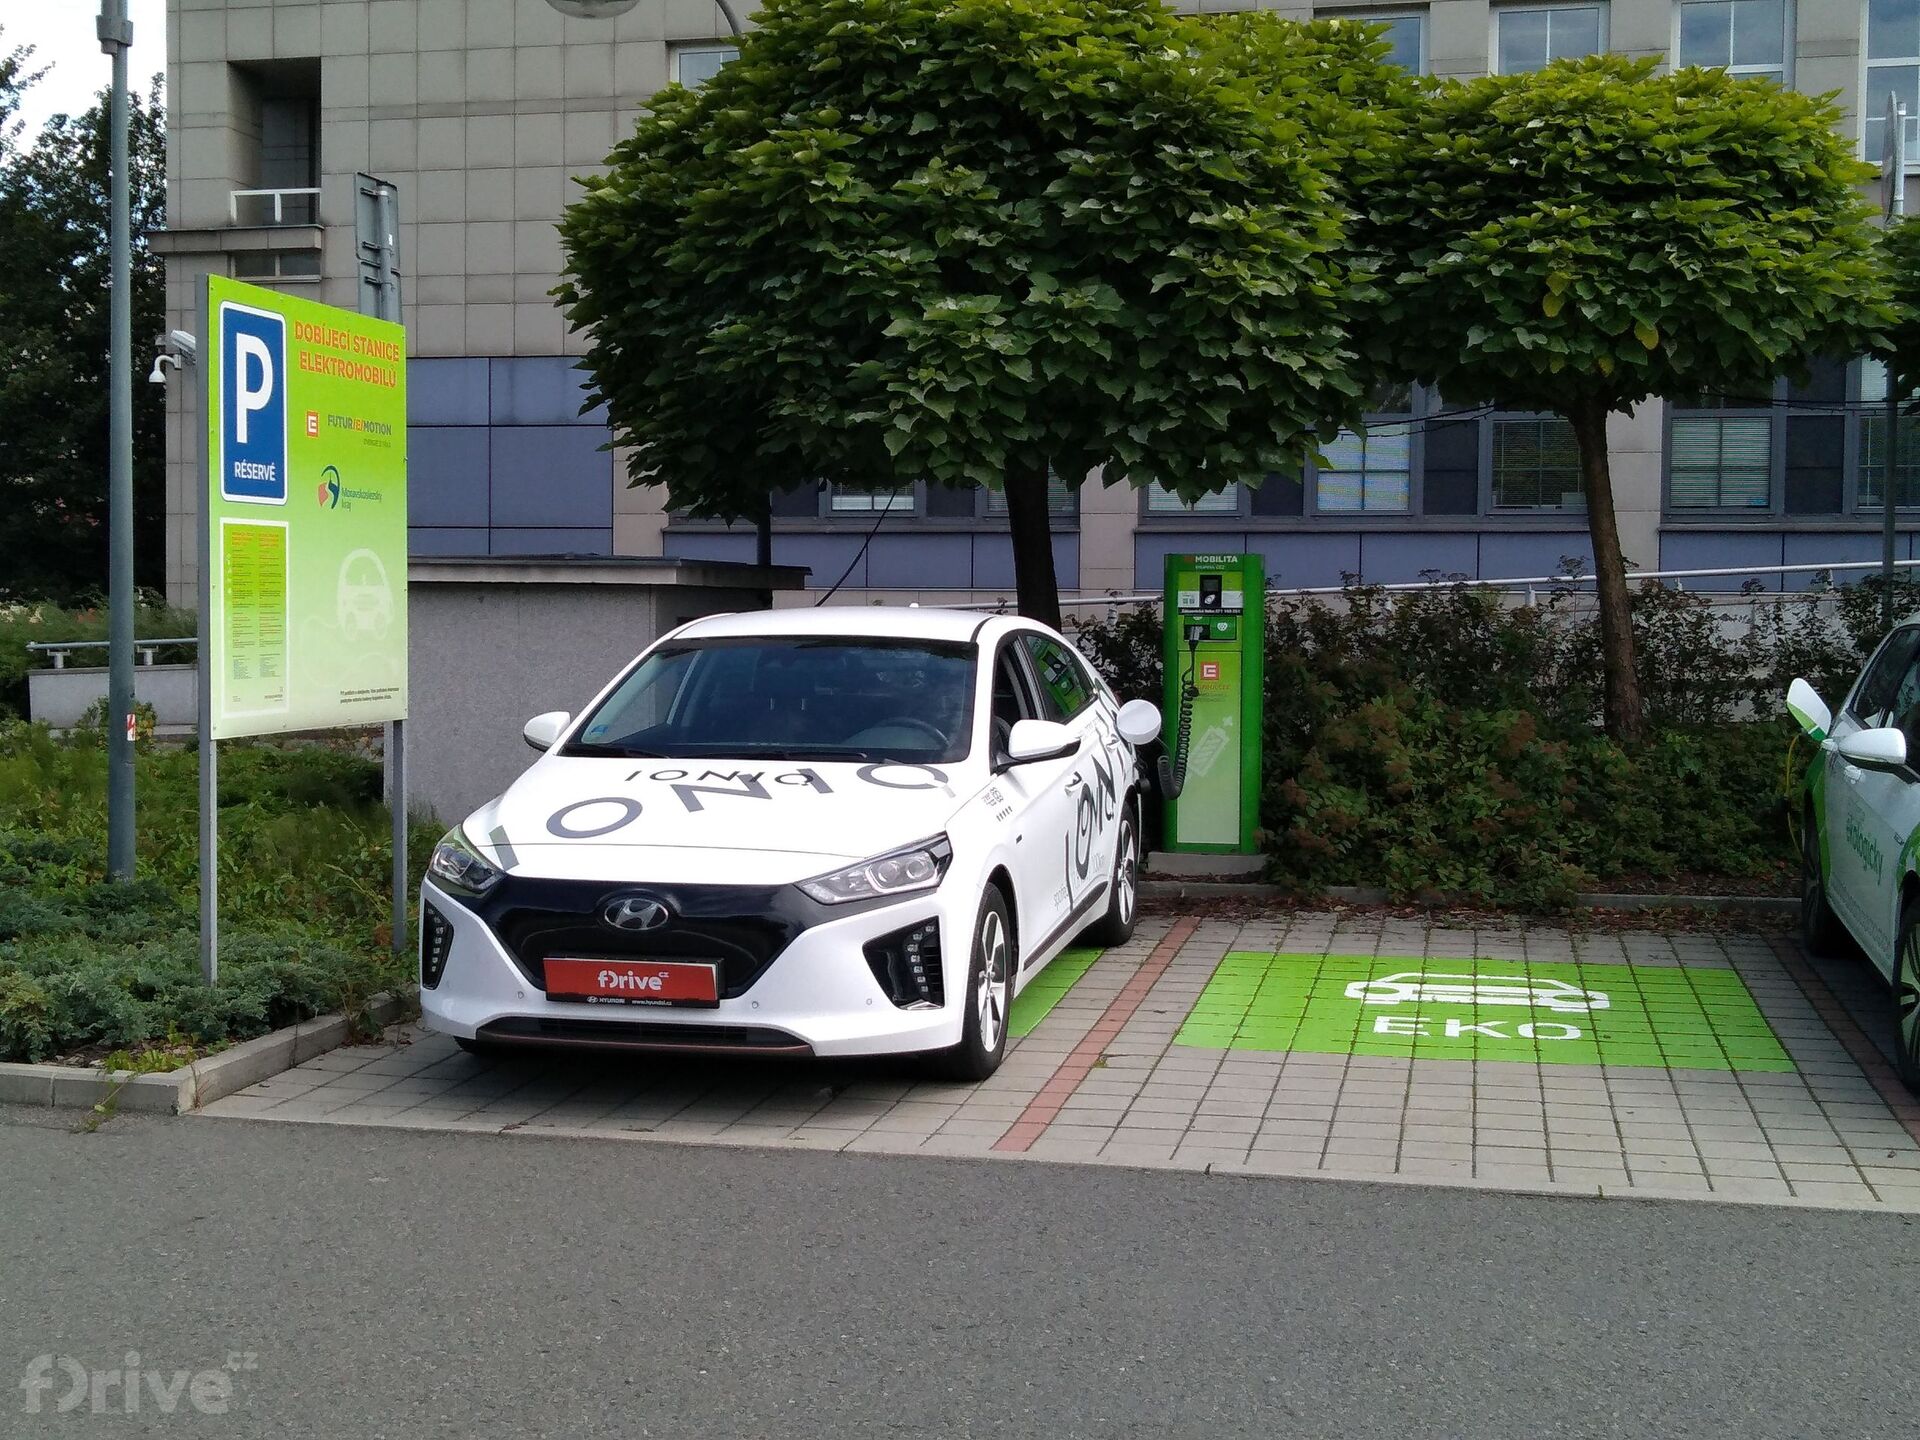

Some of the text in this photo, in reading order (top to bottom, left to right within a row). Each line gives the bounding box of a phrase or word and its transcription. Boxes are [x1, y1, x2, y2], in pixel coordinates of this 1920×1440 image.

[294, 320, 400, 362] DOBÍJECÍ STANICE
[300, 350, 397, 388] ELEKTROMOBILŮ
[236, 332, 273, 444] P
[234, 459, 276, 482] RÉSERVÉ
[1195, 555, 1238, 563] MOBILITA
[624, 769, 815, 787] IONIQ
[598, 970, 662, 991] fDrive
[1373, 1015, 1582, 1040] EKO
